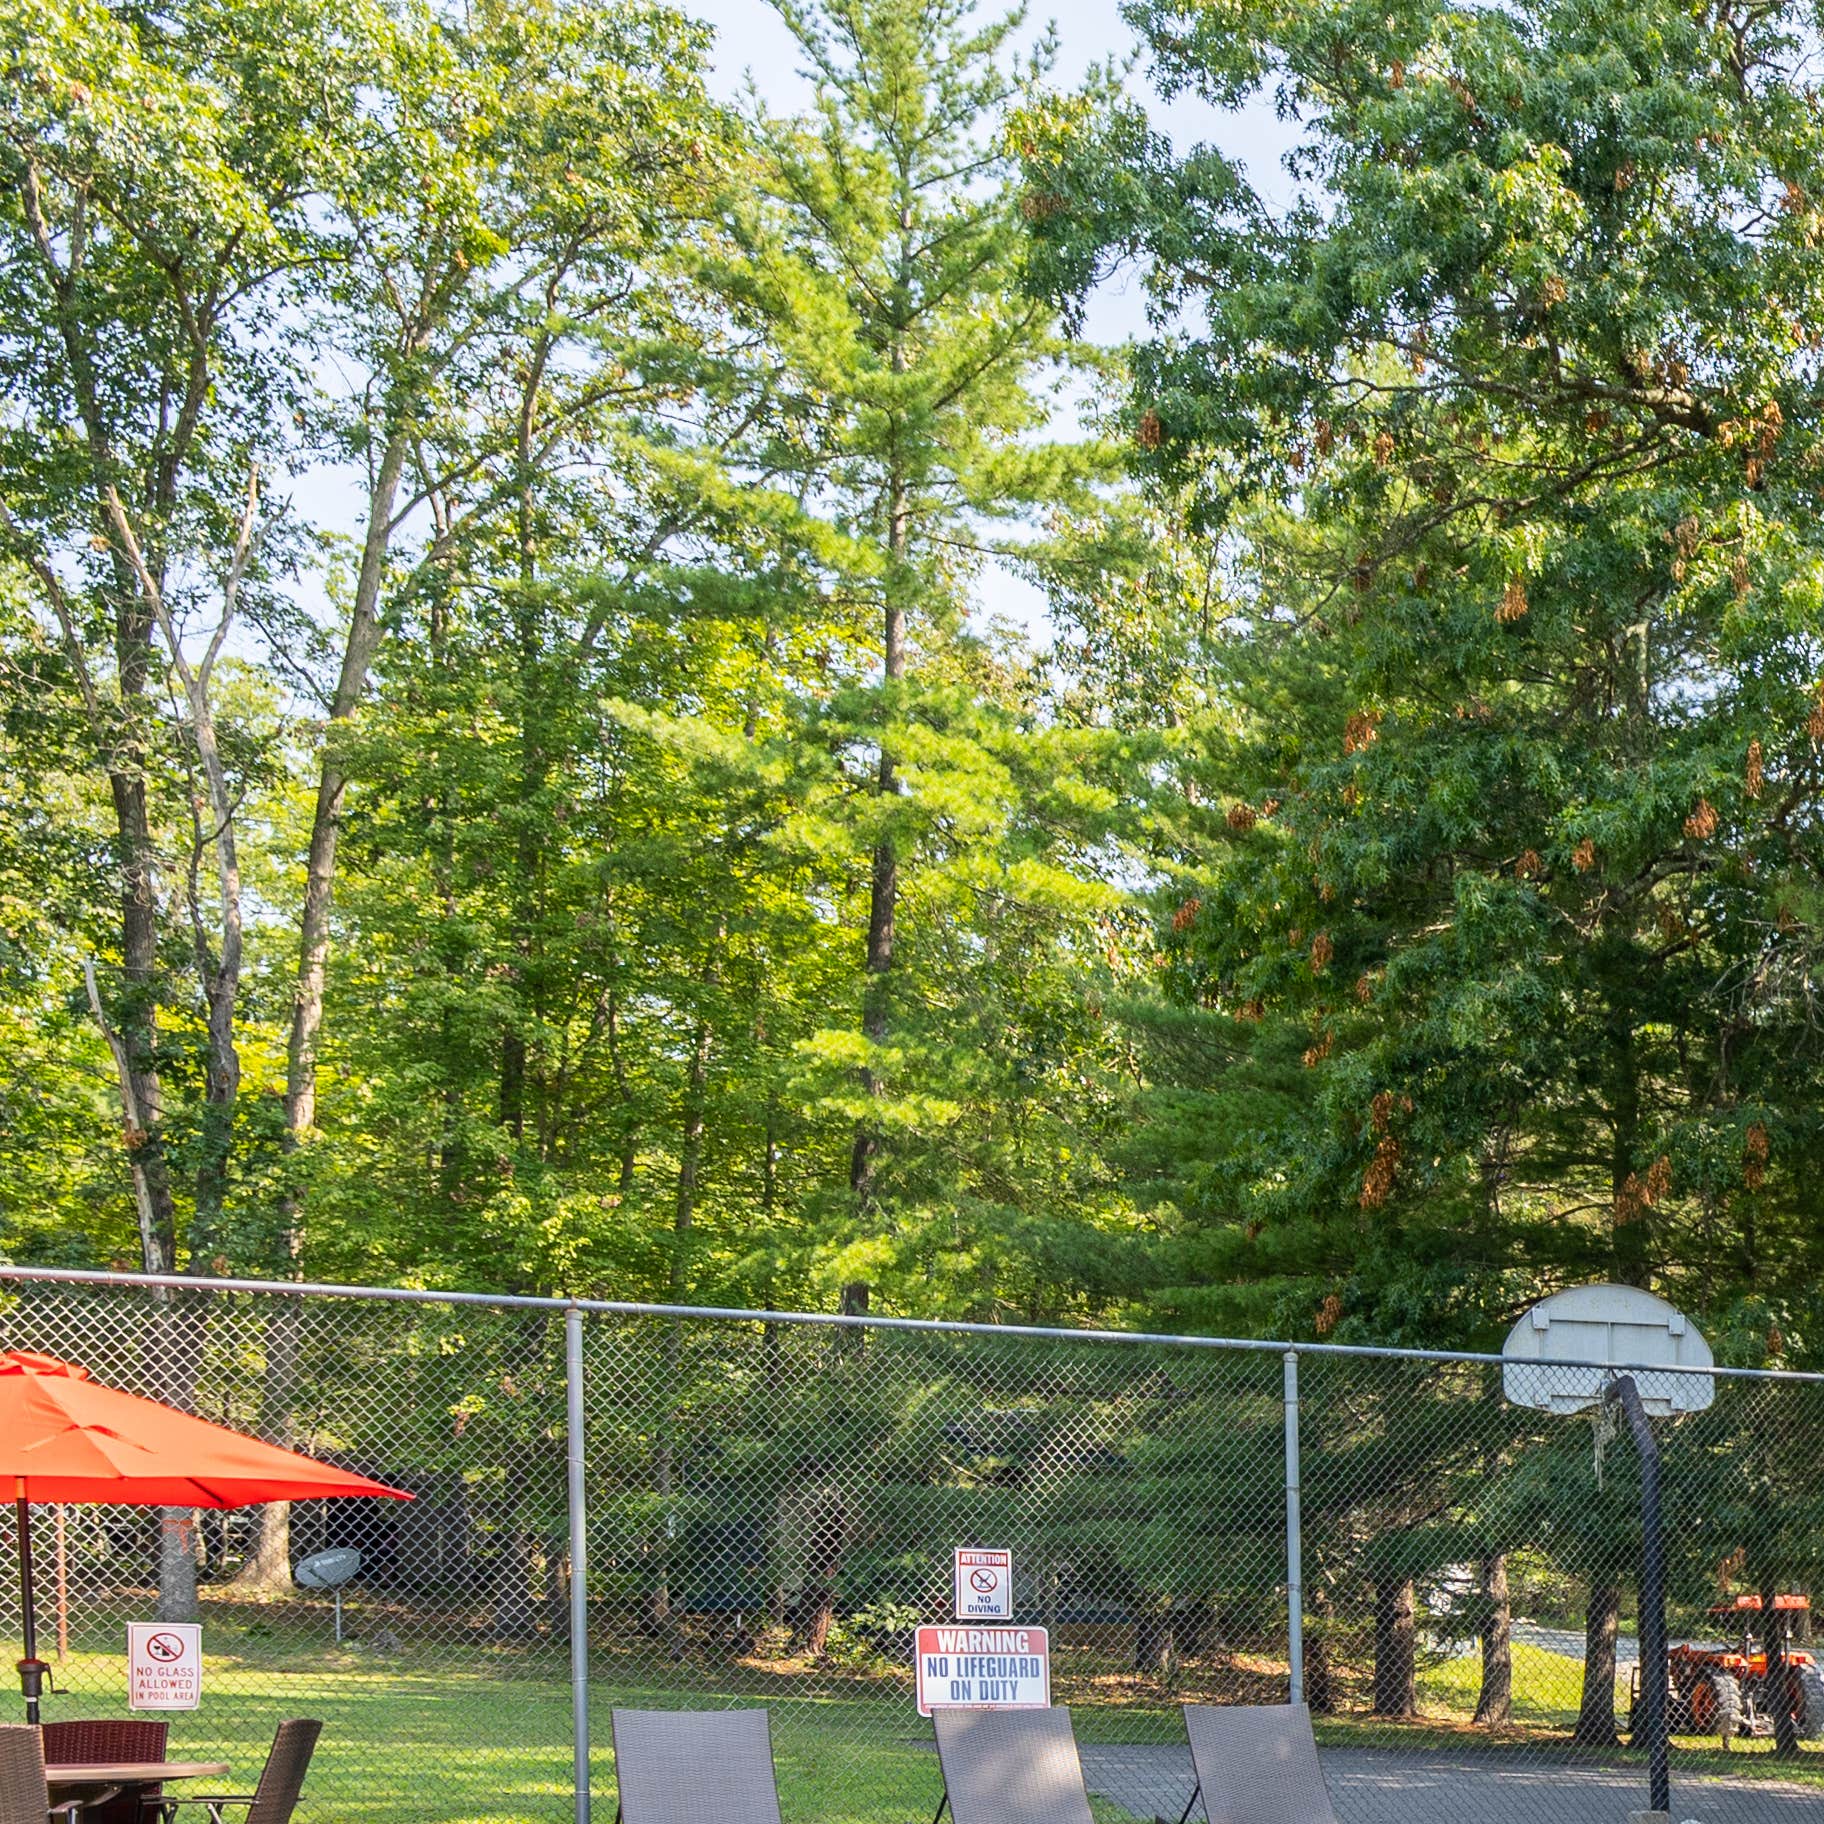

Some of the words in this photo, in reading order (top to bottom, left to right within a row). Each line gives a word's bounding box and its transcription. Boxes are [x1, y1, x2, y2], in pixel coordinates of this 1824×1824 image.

[961, 1553, 1007, 1565] ATTENTION
[977, 1595, 991, 1604] NO
[967, 1605, 1001, 1613] DIVING
[936, 1630, 1029, 1653] WARNING
[136, 1667, 152, 1676] NO
[157, 1667, 194, 1677] GLASS
[928, 1656, 948, 1678] NO
[957, 1657, 1040, 1678] LIFEGUARD
[139, 1680, 192, 1689] ALLOWED
[950, 1680, 971, 1701] ON
[979, 1680, 1019, 1701] DUTY
[148, 1692, 170, 1700] POOL
[174, 1692, 194, 1700] AREA
